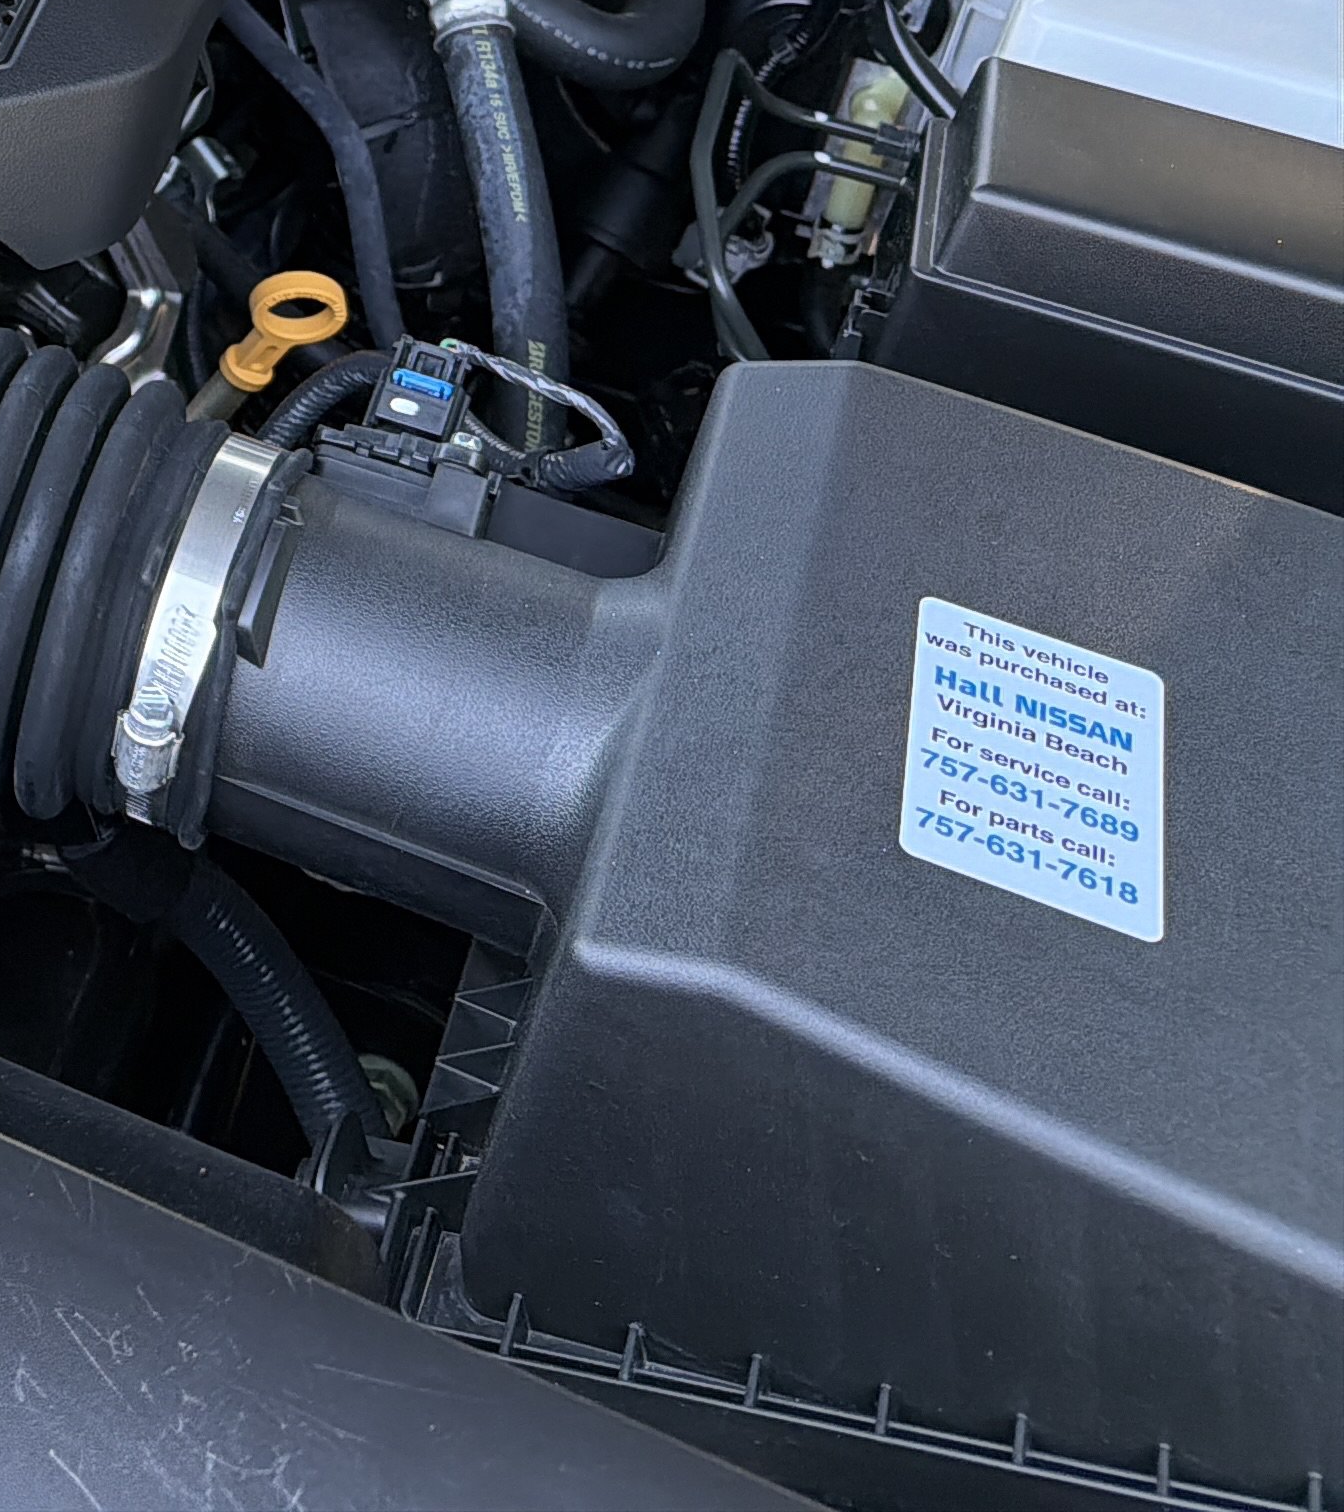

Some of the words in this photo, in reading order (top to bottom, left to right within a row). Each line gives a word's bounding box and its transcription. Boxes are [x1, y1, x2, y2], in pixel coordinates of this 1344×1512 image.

[475, 40, 498, 88] R134a
[493, 112, 512, 140] SUC
[924, 631, 972, 658] was
[979, 650, 1107, 706] purchased
[1115, 697, 1147, 719] at:
[964, 622, 1016, 653] This
[1023, 643, 1109, 684] vehicle
[934, 666, 1004, 707] Hall
[1015, 694, 1133, 752] NISSAN
[937, 694, 1036, 743] Virginia
[1045, 732, 1128, 775] Beach
[920, 748, 1140, 843] 757-631-7689
[931, 726, 974, 754] For
[980, 744, 1071, 788] service
[1077, 781, 1131, 811] call:
[916, 807, 1139, 905] 757-631-7618
[939, 789, 983, 819] For
[989, 809, 1055, 845] parts
[1061, 837, 1116, 867] call:
